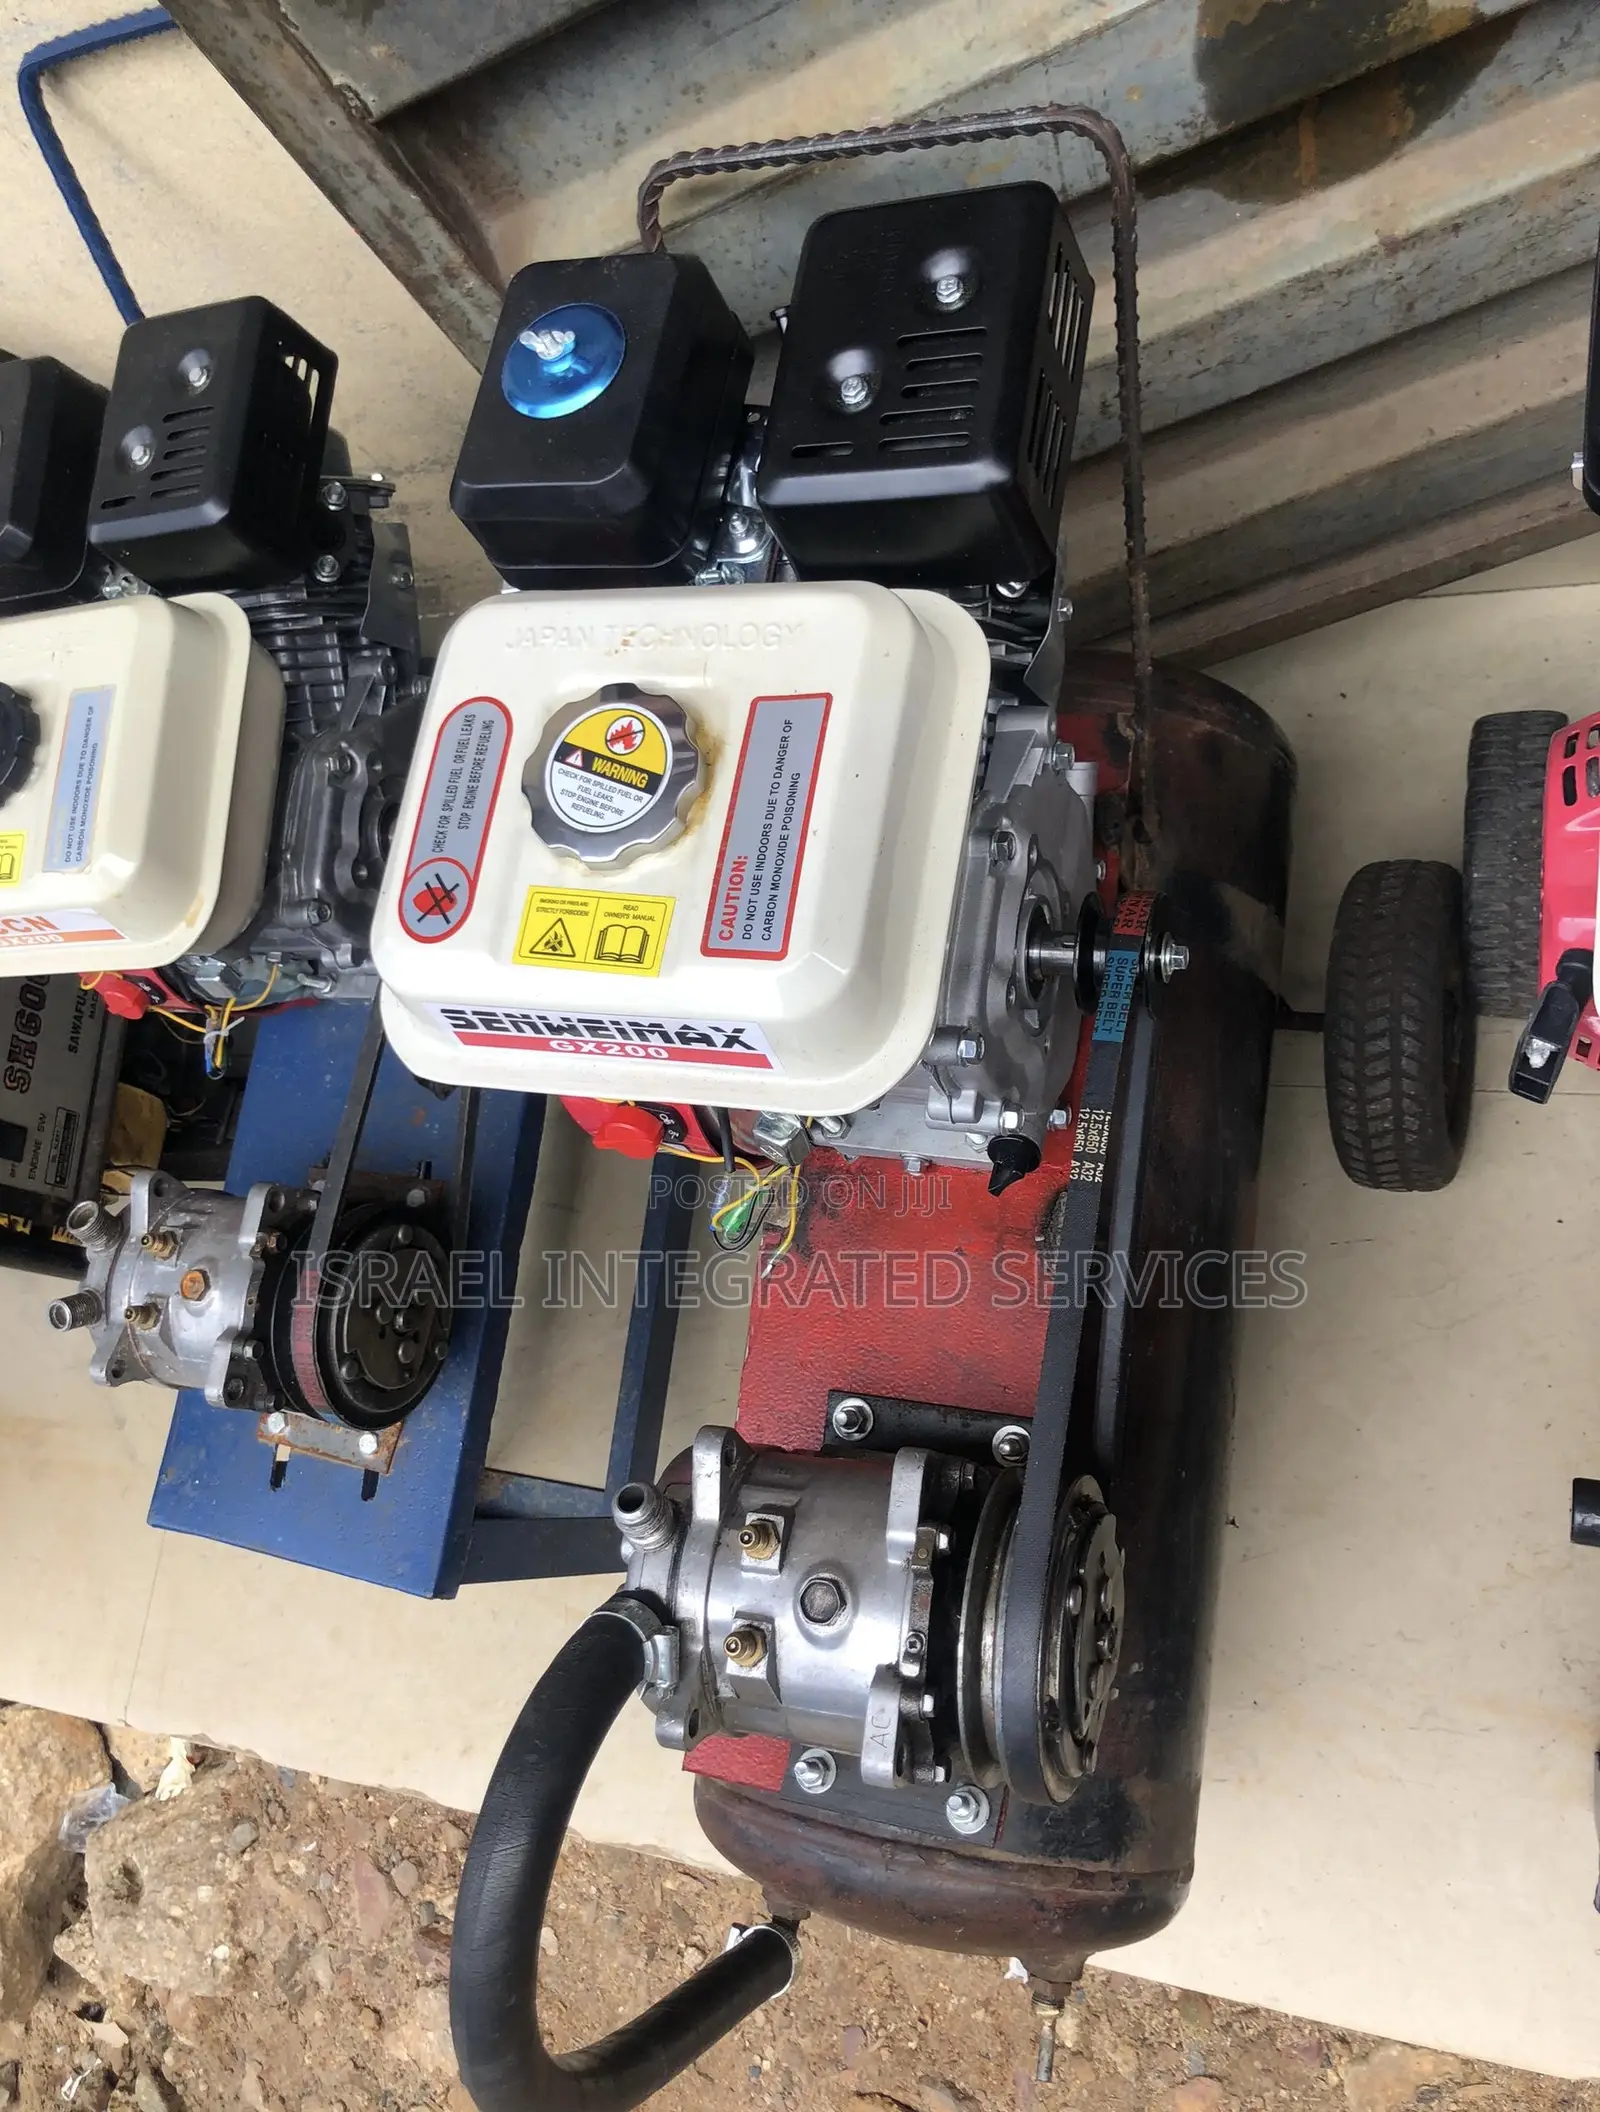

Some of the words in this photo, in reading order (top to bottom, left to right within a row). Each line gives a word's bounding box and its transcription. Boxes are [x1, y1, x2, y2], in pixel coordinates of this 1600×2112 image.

[505, 625, 594, 649] JAPAN
[603, 622, 804, 650] TECHNOLOGY
[82, 717, 92, 749] DANGER
[460, 714, 476, 737] LEAKS
[476, 719, 494, 756] REFUELING
[782, 719, 793, 733] OF
[80, 749, 87, 761] TO
[453, 754, 465, 764] OR
[456, 738, 470, 754] FUEL
[773, 735, 790, 779] DANGER
[77, 762, 85, 778] DUE
[448, 767, 463, 784] FUEL
[469, 757, 486, 784] BEFORE
[591, 757, 649, 789] WARNING
[72, 779, 82, 815] INDOORS
[442, 785, 458, 812] SPILLED
[462, 785, 478, 810] ENGINE
[558, 768, 579, 780] CHECK
[580, 775, 592, 785] FOR
[592, 778, 617, 794] SPILLED
[617, 787, 633, 800] FUEL
[633, 794, 644, 803] OR
[577, 784, 592, 796] FUEL
[770, 776, 780, 796] TO
[80, 786, 92, 827] MONOXIDE
[560, 789, 576, 799] STOP
[577, 794, 600, 807] ENGINE
[600, 801, 625, 816] BEFORE
[765, 799, 777, 821] DUE
[438, 815, 451, 830] FOR
[457, 812, 472, 830] STOP
[76, 828, 85, 862] CARBON
[432, 829, 448, 853] CHECK
[755, 823, 773, 872] INDOORS
[64, 853, 71, 863] DO
[761, 893, 778, 941] CARBON
[772, 833, 790, 892] MONOXIDE
[781, 772, 801, 831] POISONING
[718, 855, 749, 942] CAUTION:
[749, 875, 763, 896] USE
[746, 899, 757, 922] NOT
[743, 924, 752, 940] DO
[1108, 957, 1129, 999] SUPER
[440, 1008, 759, 1051] SENWEIMAX
[1101, 1002, 1118, 1034] BELT
[548, 1039, 670, 1059] GX200
[1085, 1109, 1105, 1154] 12.5x850
[28, 1138, 43, 1180] ENGINE
[37, 1112, 47, 1133] SW
[1080, 1161, 1096, 1182] A32
